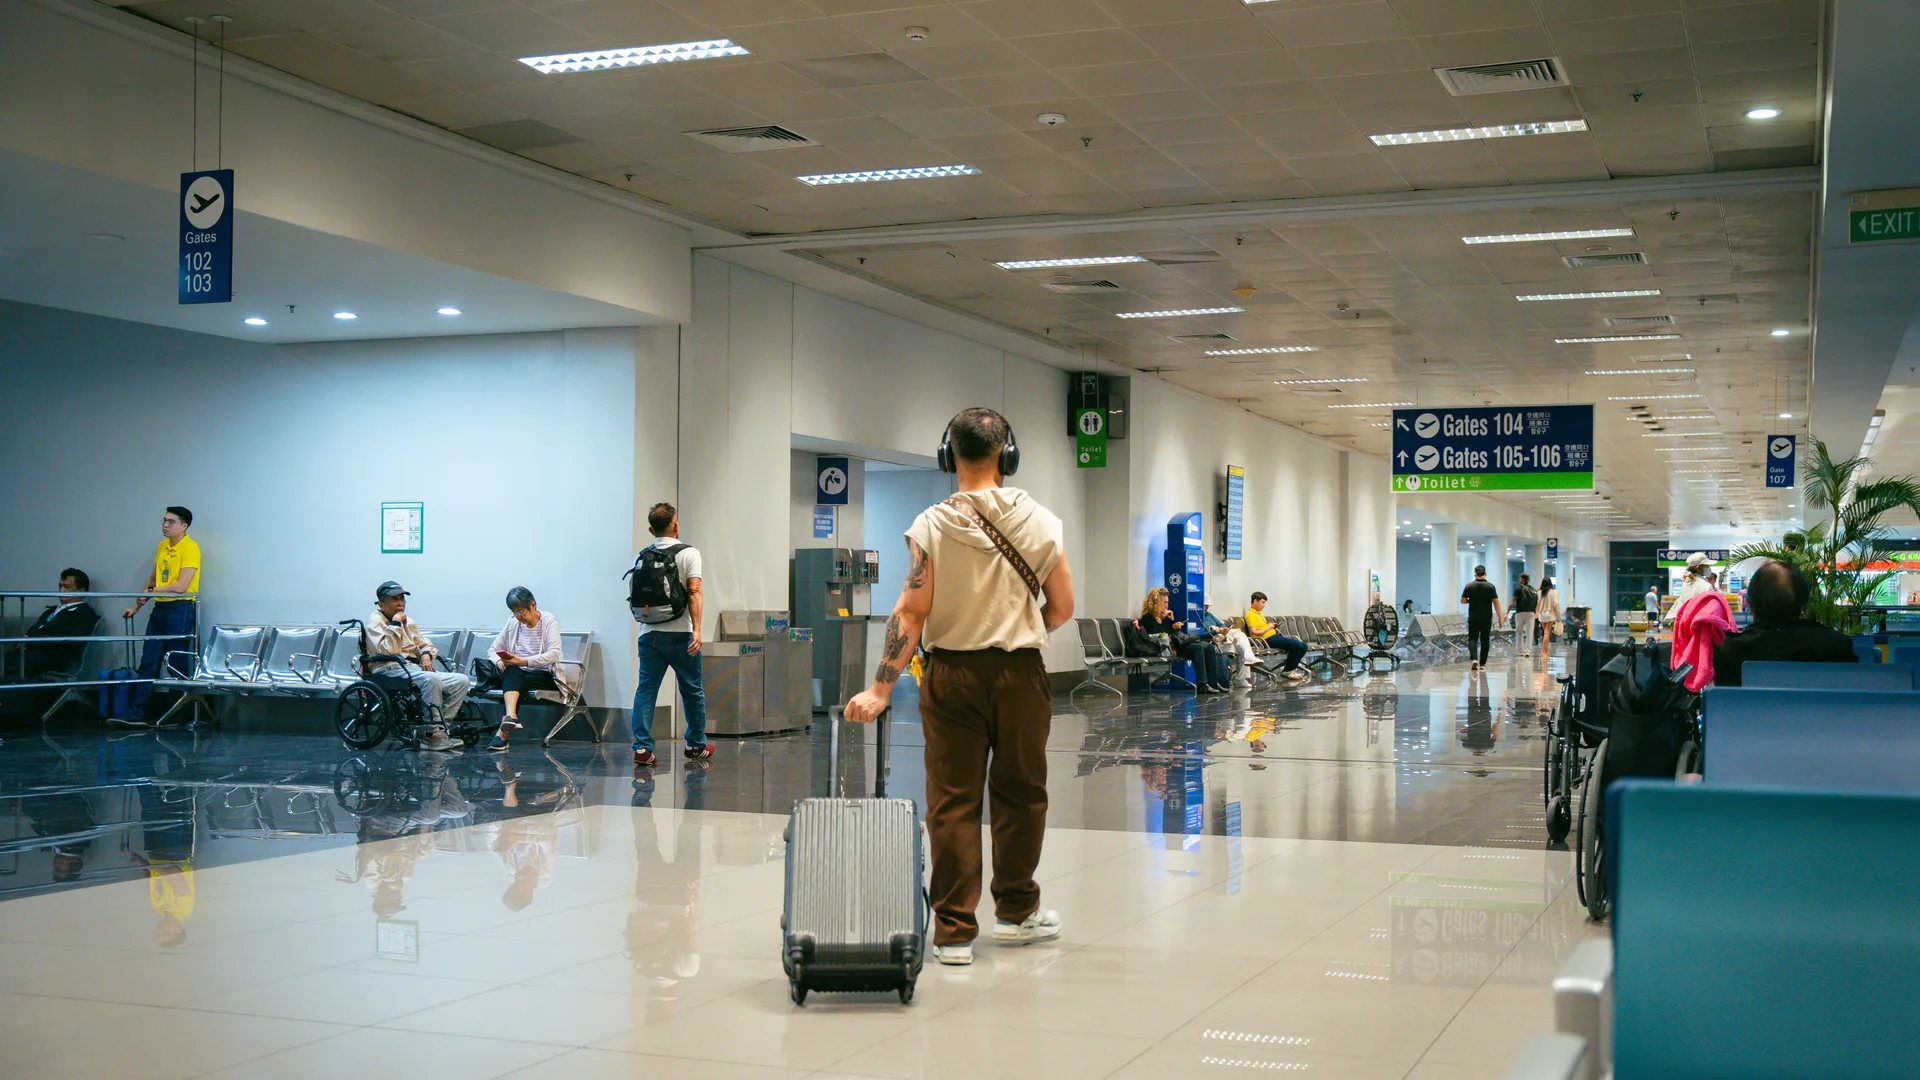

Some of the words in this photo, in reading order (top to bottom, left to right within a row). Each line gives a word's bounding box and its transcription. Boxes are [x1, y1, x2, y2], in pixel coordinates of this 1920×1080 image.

[1870, 212, 1915, 234] EXIT
[185, 231, 217, 244] Gates
[184, 251, 212, 271] 102
[184, 273, 212, 293] 103
[1443, 413, 1488, 436] Gates
[1493, 412, 1524, 435] 104
[1443, 446, 1488, 469] Gates
[1493, 444, 1561, 468] 105-106
[1421, 476, 1466, 489] Toilet
[1769, 475, 1786, 484] 107
[747, 645, 762, 653] Paper
